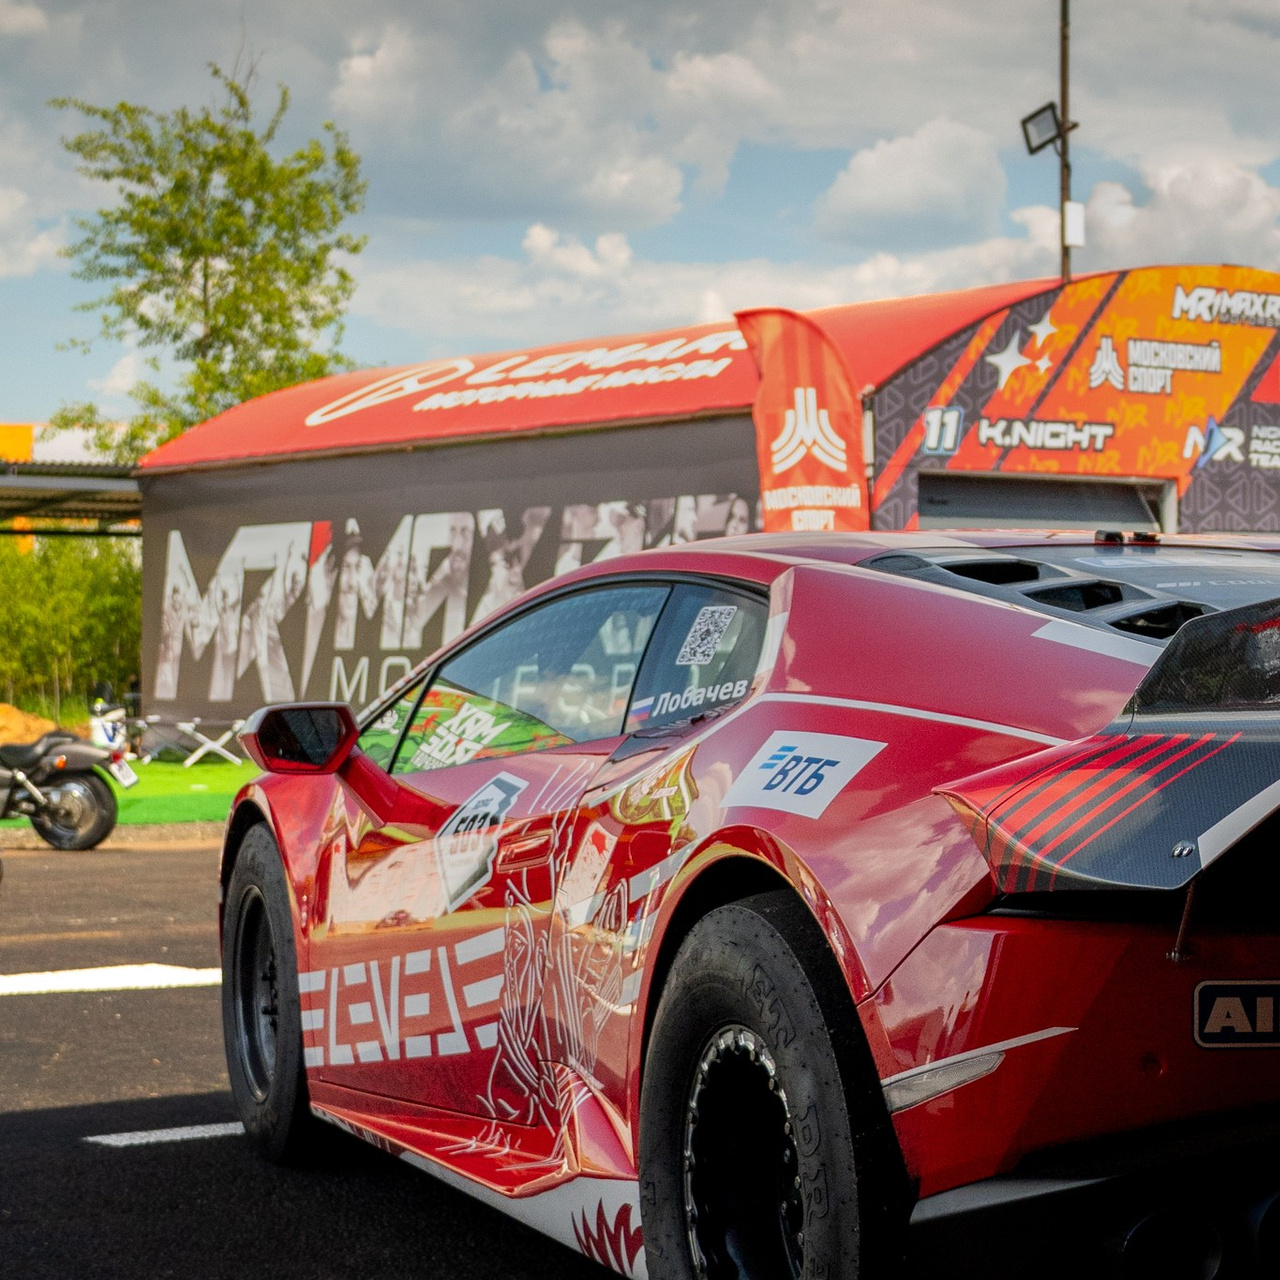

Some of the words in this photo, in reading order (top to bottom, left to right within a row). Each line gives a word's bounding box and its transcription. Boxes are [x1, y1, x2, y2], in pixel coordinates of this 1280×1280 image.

[1127, 338, 1221, 373] МОСКОВСКИЙ
[1127, 366, 1173, 395] СПОРТ
[925, 408, 959, 451] 11
[979, 418, 1113, 451] K.NIGHT
[763, 483, 861, 511] МОСКОВСКИЙ
[791, 509, 835, 532] СПОРТ
[652, 679, 748, 718] Лобачев
[763, 755, 841, 796] ВТБ
